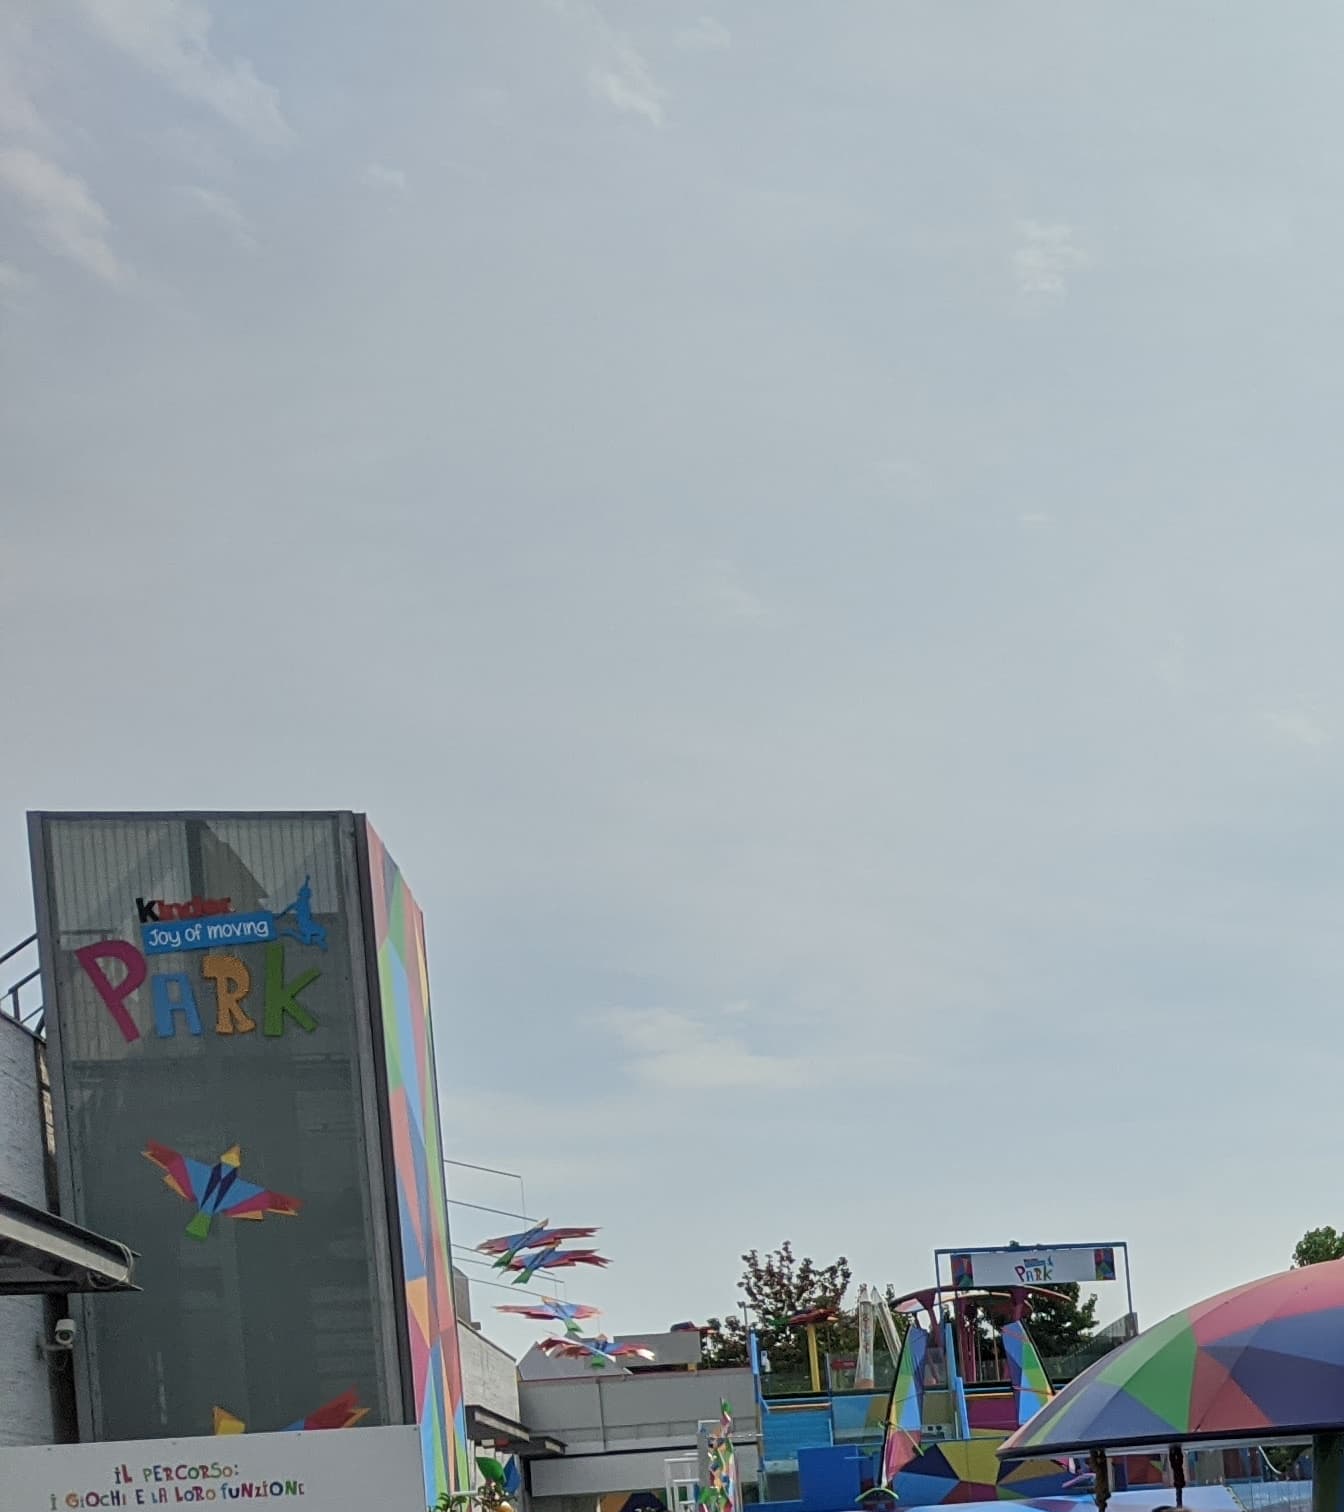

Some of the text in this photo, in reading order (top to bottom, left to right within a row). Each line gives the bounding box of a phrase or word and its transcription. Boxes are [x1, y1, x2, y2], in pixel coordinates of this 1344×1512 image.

[148, 920, 269, 947] Joy of moving
[136, 1488, 144, 1505] E
[151, 1487, 168, 1504] LA
